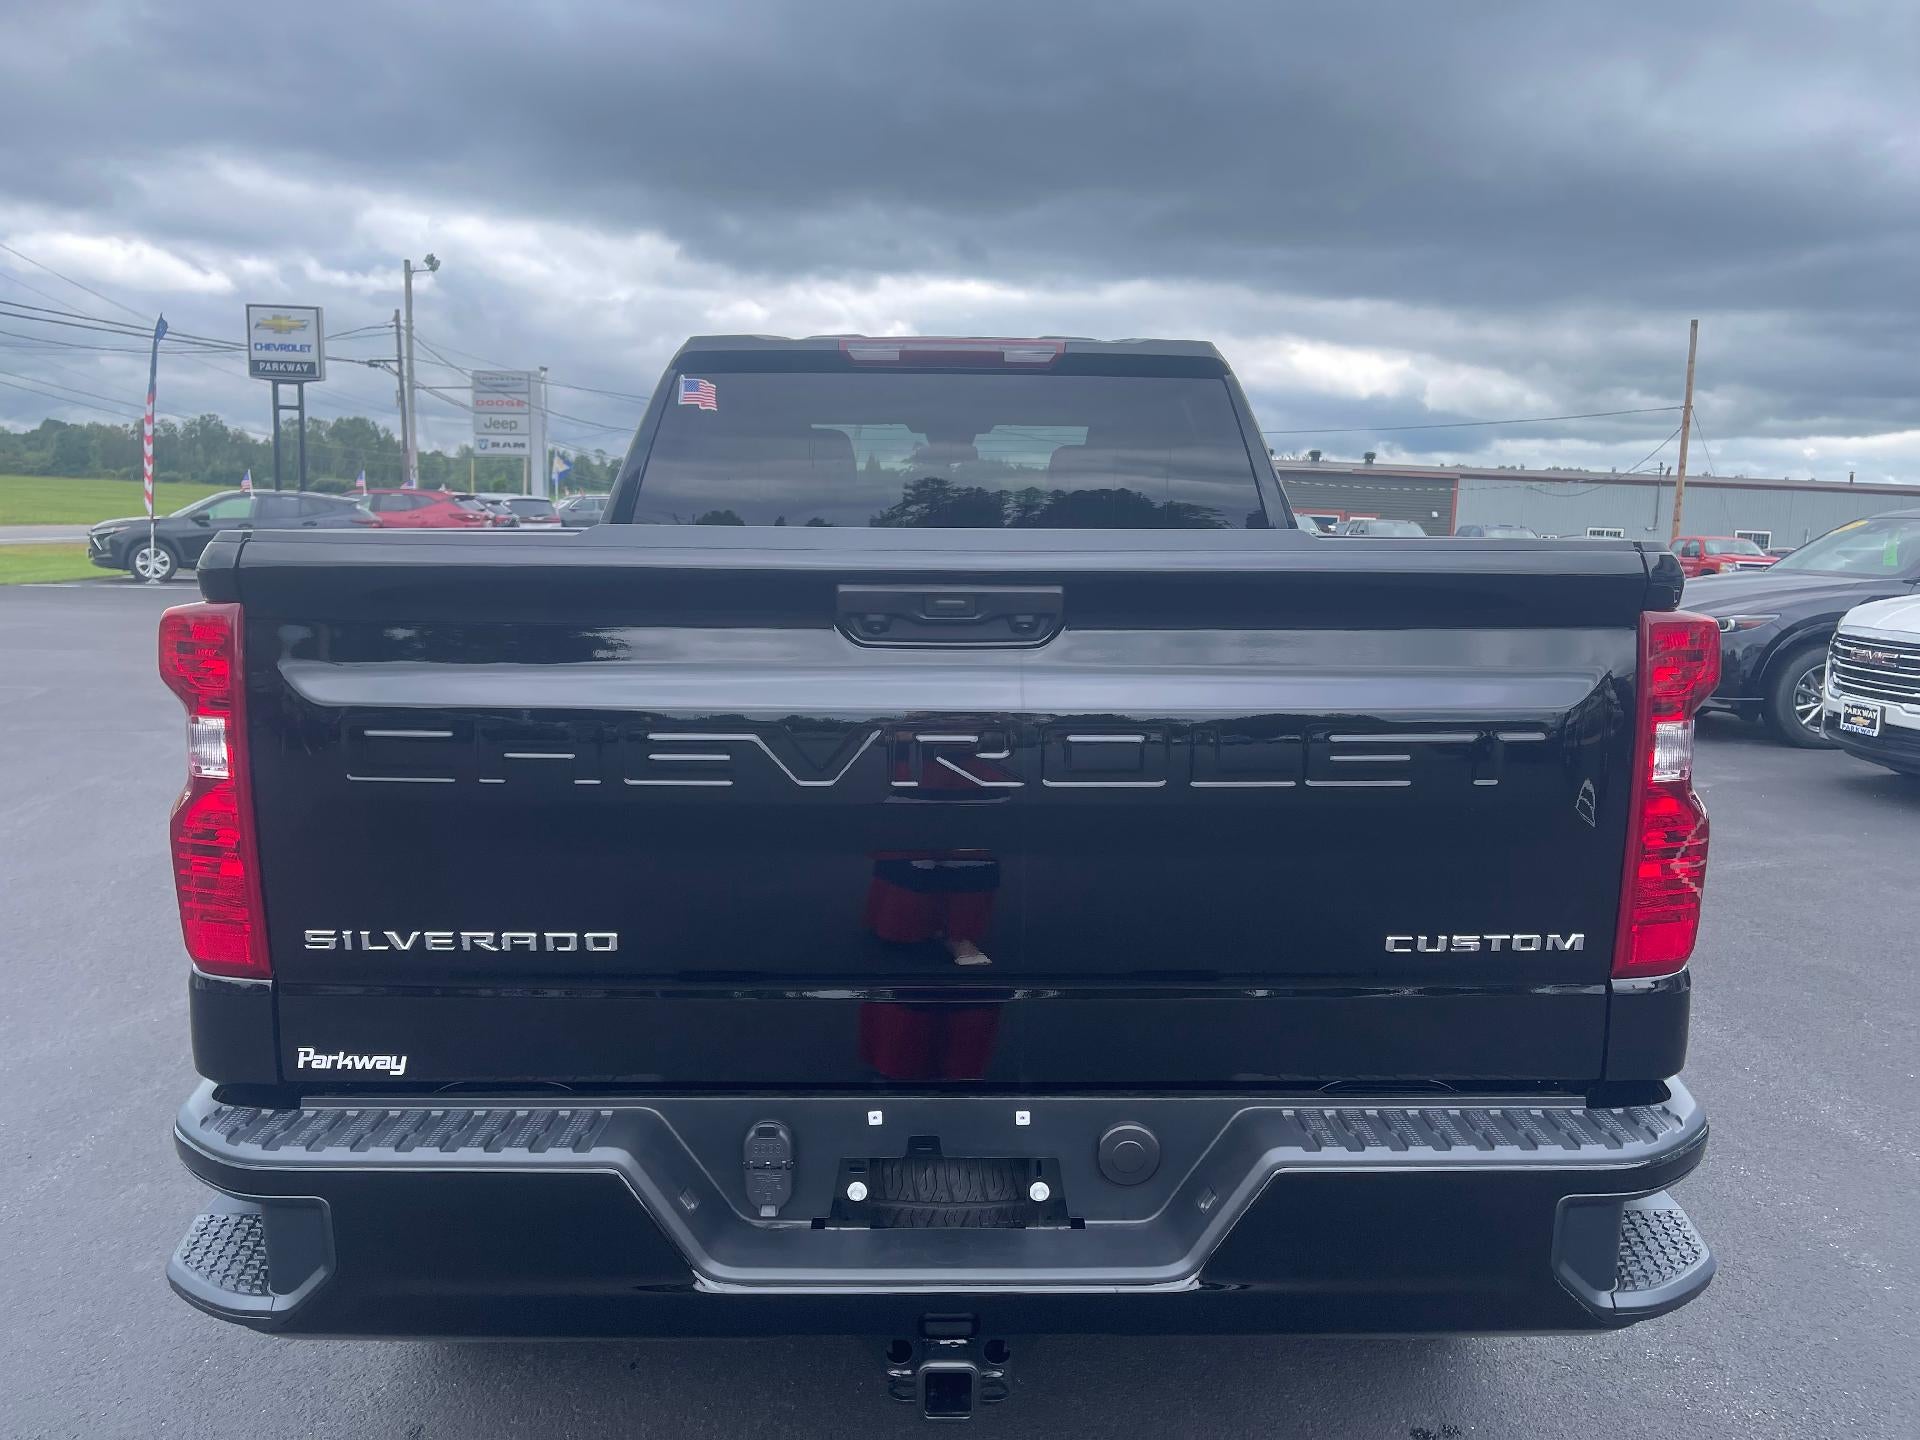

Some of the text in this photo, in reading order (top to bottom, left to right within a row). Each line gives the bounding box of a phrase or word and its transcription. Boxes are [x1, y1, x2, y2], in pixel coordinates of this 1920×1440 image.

[254, 342, 312, 353] CHEVROLET
[259, 362, 309, 373] PARKWAY
[475, 399, 525, 408] DODGE
[483, 416, 518, 432] Jeep
[490, 441, 526, 449] RAM
[1844, 706, 1878, 720] PARKWAY
[344, 722, 1547, 788] CHEVROLET
[304, 930, 618, 951] SILVERADO
[1385, 933, 1585, 952] CUSTOM
[297, 1047, 408, 1076] Parkway
